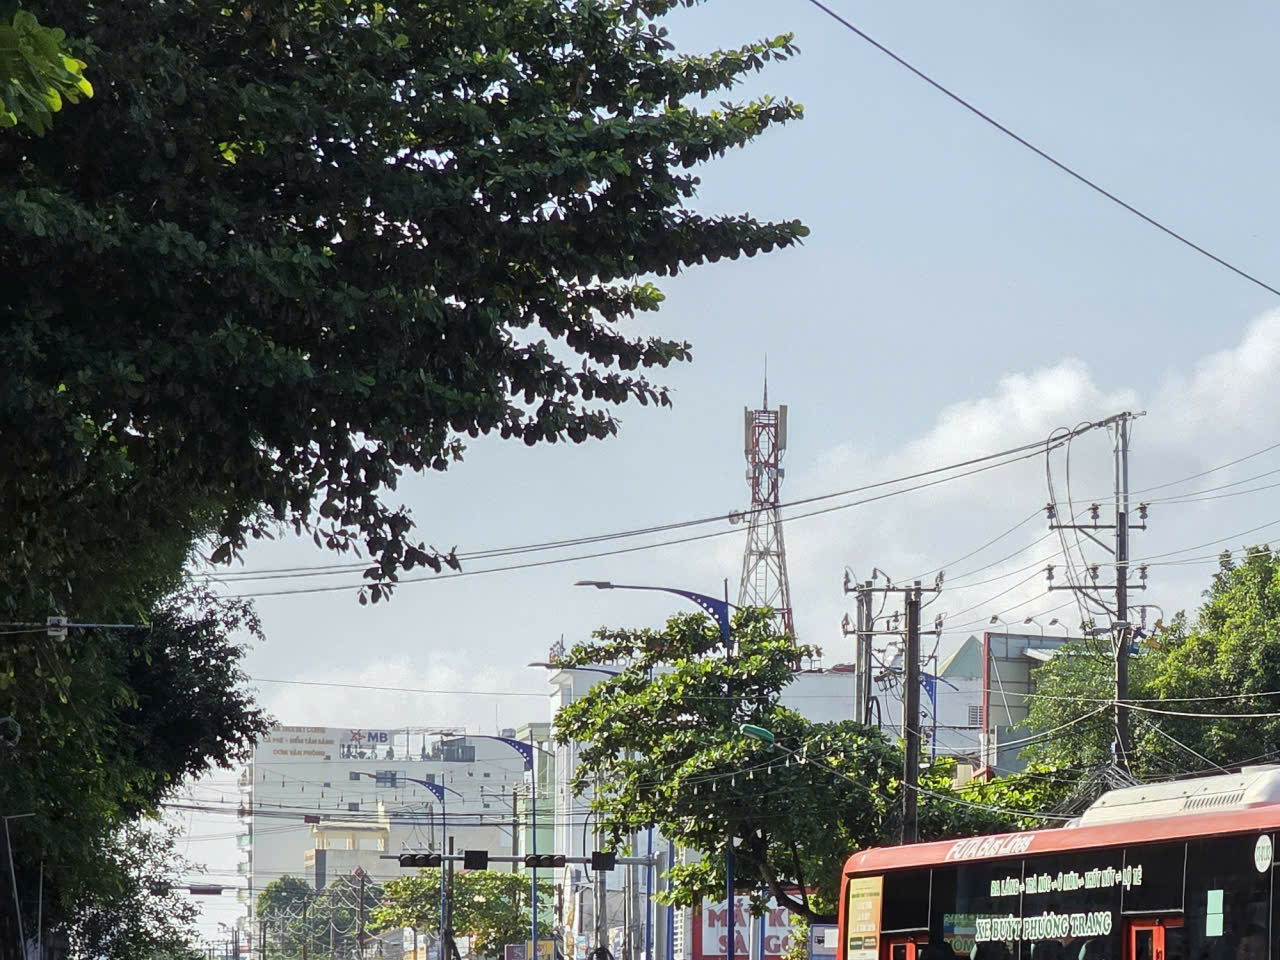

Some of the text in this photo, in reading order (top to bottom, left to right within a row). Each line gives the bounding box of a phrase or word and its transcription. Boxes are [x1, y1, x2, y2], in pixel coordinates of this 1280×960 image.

[367, 732, 389, 743] MB
[990, 880, 1000, 897] BA
[1000, 876, 1020, 897] LÁNG
[1122, 865, 1132, 892] LỘ
[707, 898, 752, 928] MẮ
[975, 917, 991, 942] XE
[991, 913, 1021, 941] BUÝT
[1022, 911, 1069, 940] PHƯƠNG
[1070, 911, 1112, 938] TRANG
